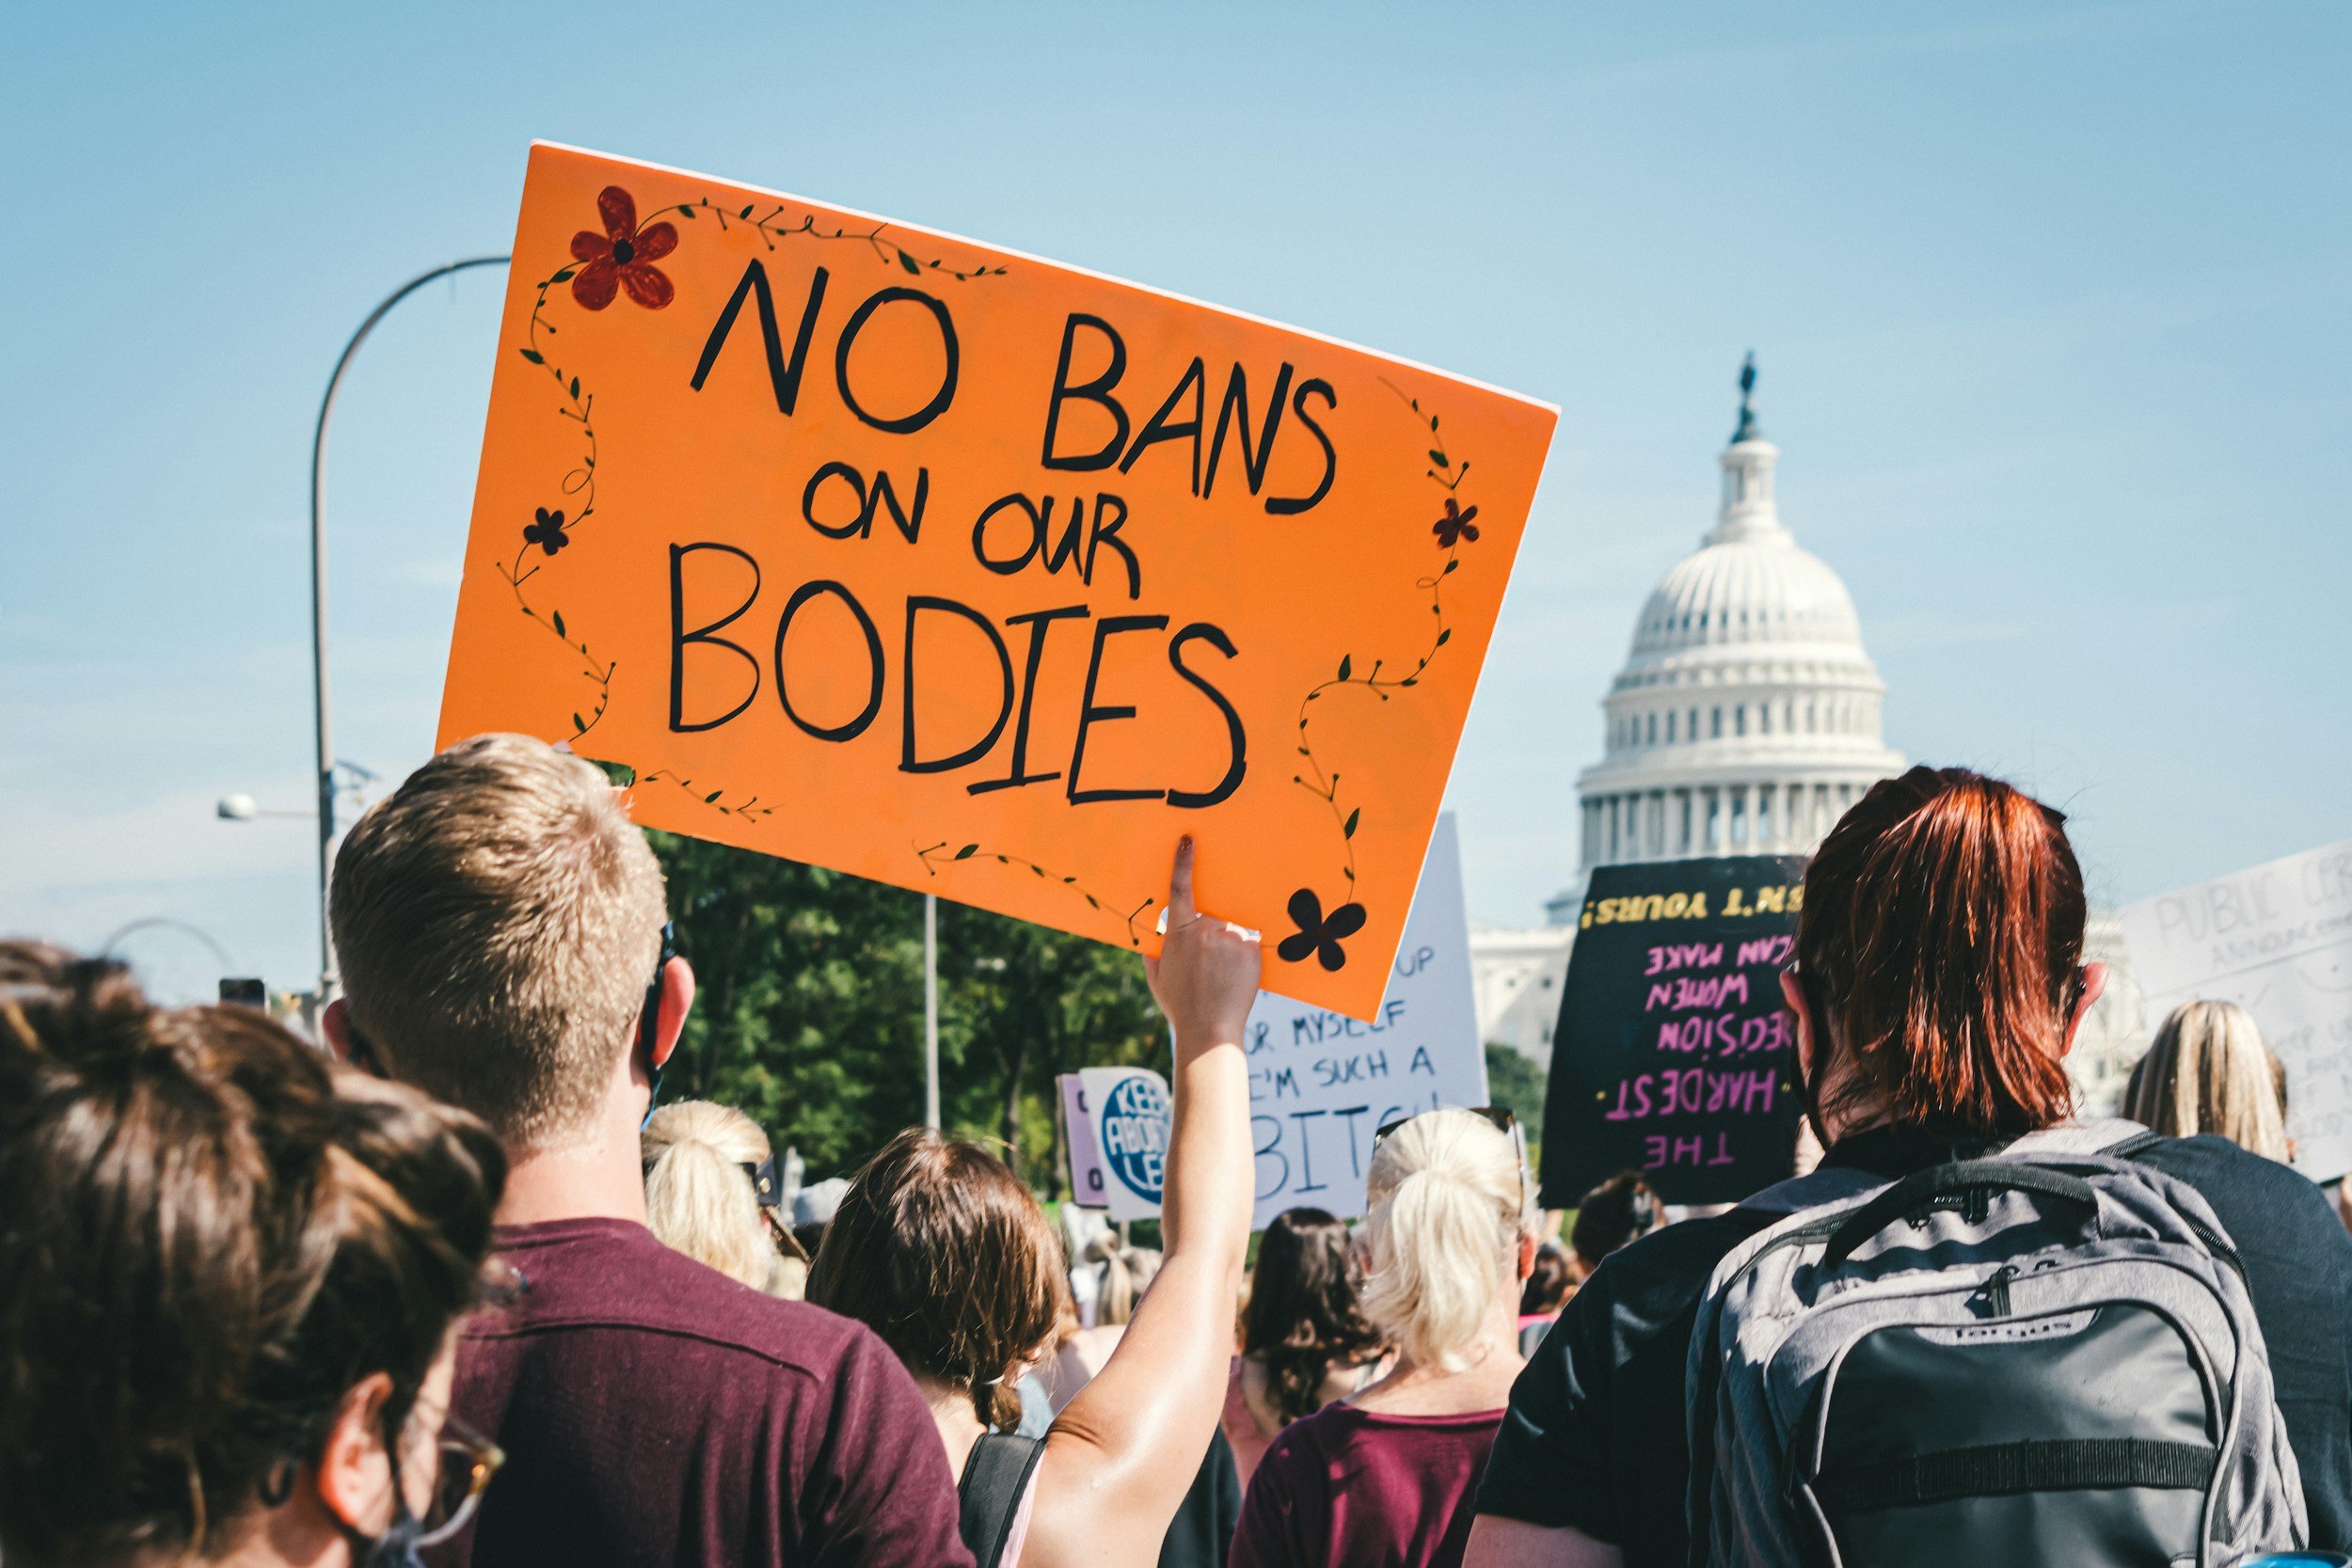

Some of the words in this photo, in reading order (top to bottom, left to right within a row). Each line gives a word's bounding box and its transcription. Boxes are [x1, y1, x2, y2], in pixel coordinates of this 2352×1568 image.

[690, 258, 960, 435] NO
[1041, 311, 1338, 515] BANS
[802, 460, 930, 545] ON
[971, 491, 1141, 600] OUR
[668, 541, 1248, 808] BODIES
[1581, 891, 1708, 930] YOURS!
[1394, 945, 1435, 977] UP
[1644, 942, 1724, 976] MAKE
[1737, 935, 1794, 967] CAN
[1645, 973, 1748, 1012] WOMEN
[1312, 1049, 1389, 1088] SUCH
[1410, 1045, 1436, 1076] A
[1605, 1069, 1776, 1120] HARDEST
[1643, 1132, 1735, 1170] THE
